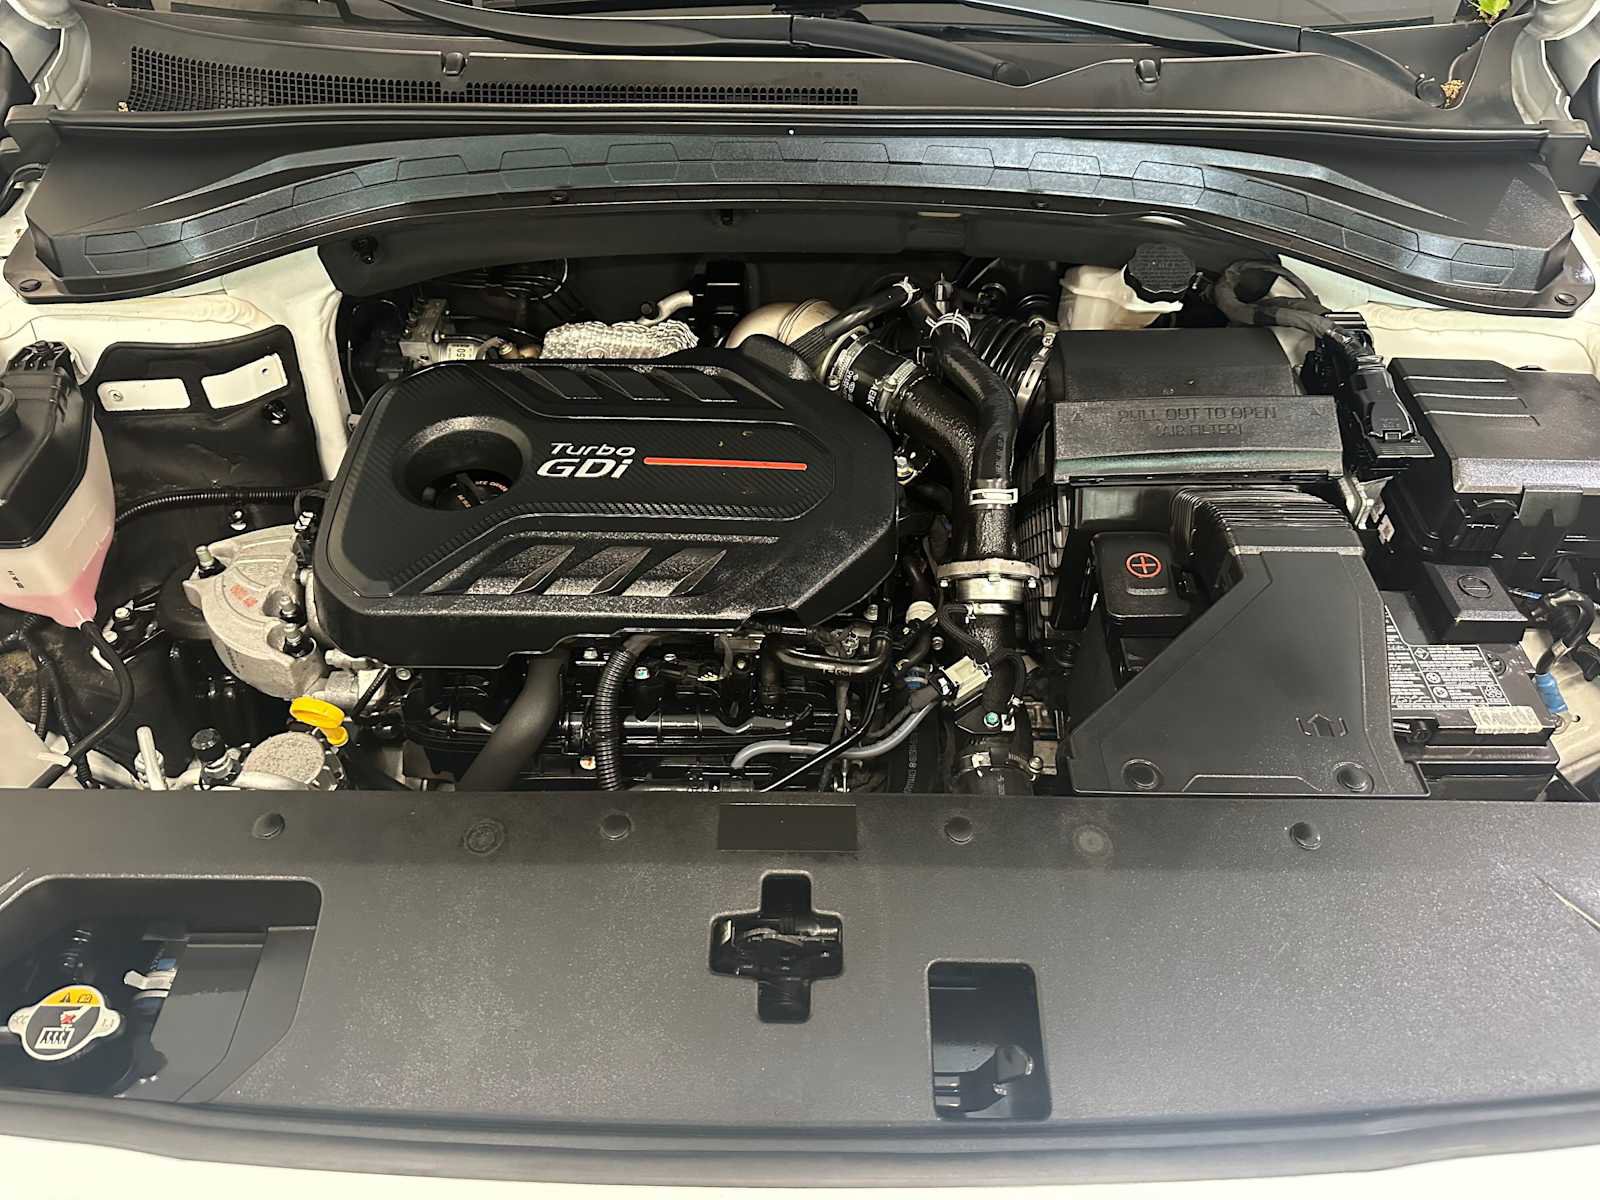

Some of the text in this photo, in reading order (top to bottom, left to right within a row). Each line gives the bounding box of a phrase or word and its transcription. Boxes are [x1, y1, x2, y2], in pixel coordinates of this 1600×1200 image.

[1117, 406, 1278, 422] PULL OUT TO OPEN
[551, 442, 636, 457] Turbo
[536, 458, 634, 479] GDi
